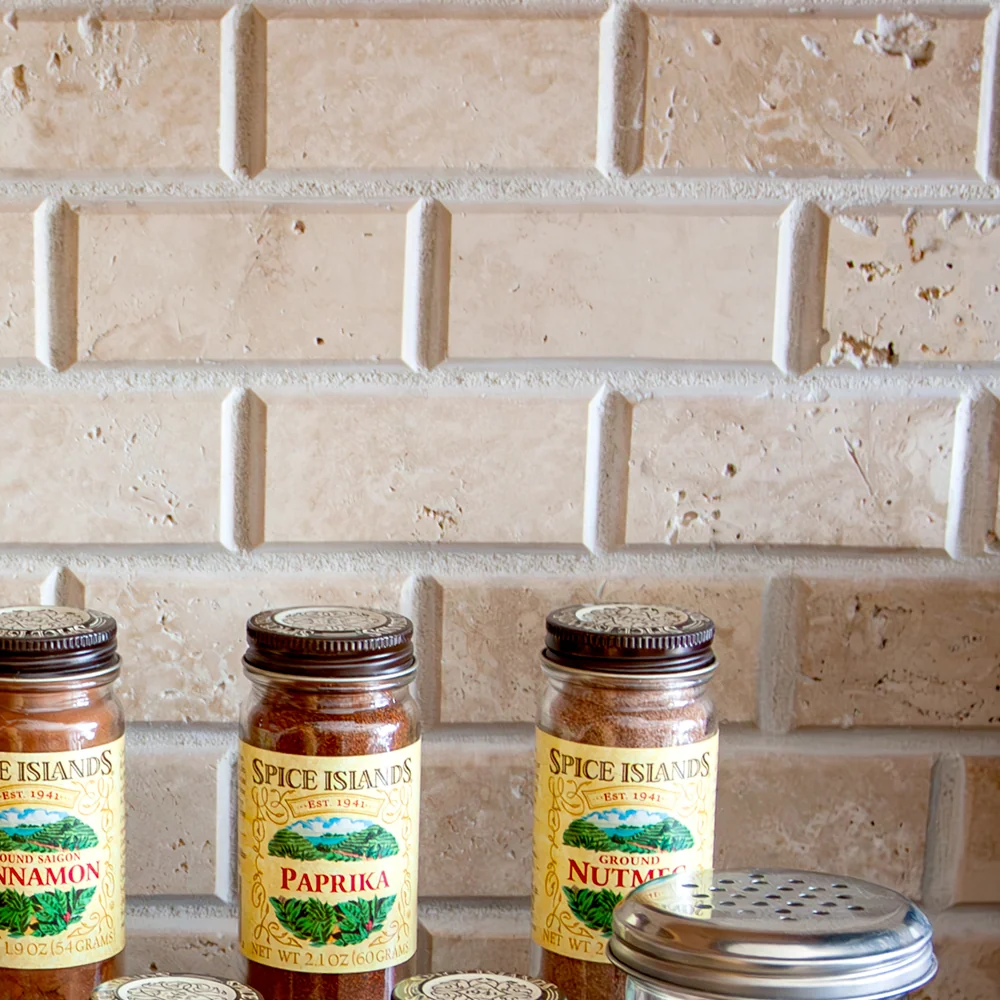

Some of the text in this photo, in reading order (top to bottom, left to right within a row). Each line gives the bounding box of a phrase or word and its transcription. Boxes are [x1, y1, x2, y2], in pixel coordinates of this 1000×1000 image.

[18, 749, 112, 781] ISLANDS
[252, 757, 412, 791] SPICE ISLANDS
[550, 748, 710, 783] SPICE ISLANDS
[2, 790, 60, 800] EST. 1941
[308, 799, 365, 809] EST. 1941
[604, 792, 661, 802] EST. 1941
[38, 852, 81, 864] SAIGON
[599, 854, 660, 865] GROUND
[280, 866, 390, 893] PAPRIKA
[26, 942, 48, 956] OZ
[542, 929, 562, 947] NET
[568, 937, 590, 953] WT
[252, 942, 272, 960] NET
[278, 949, 300, 965] WT
[305, 952, 324, 967] 2.1
[328, 953, 349, 966] OZ
[352, 951, 374, 967] (60
